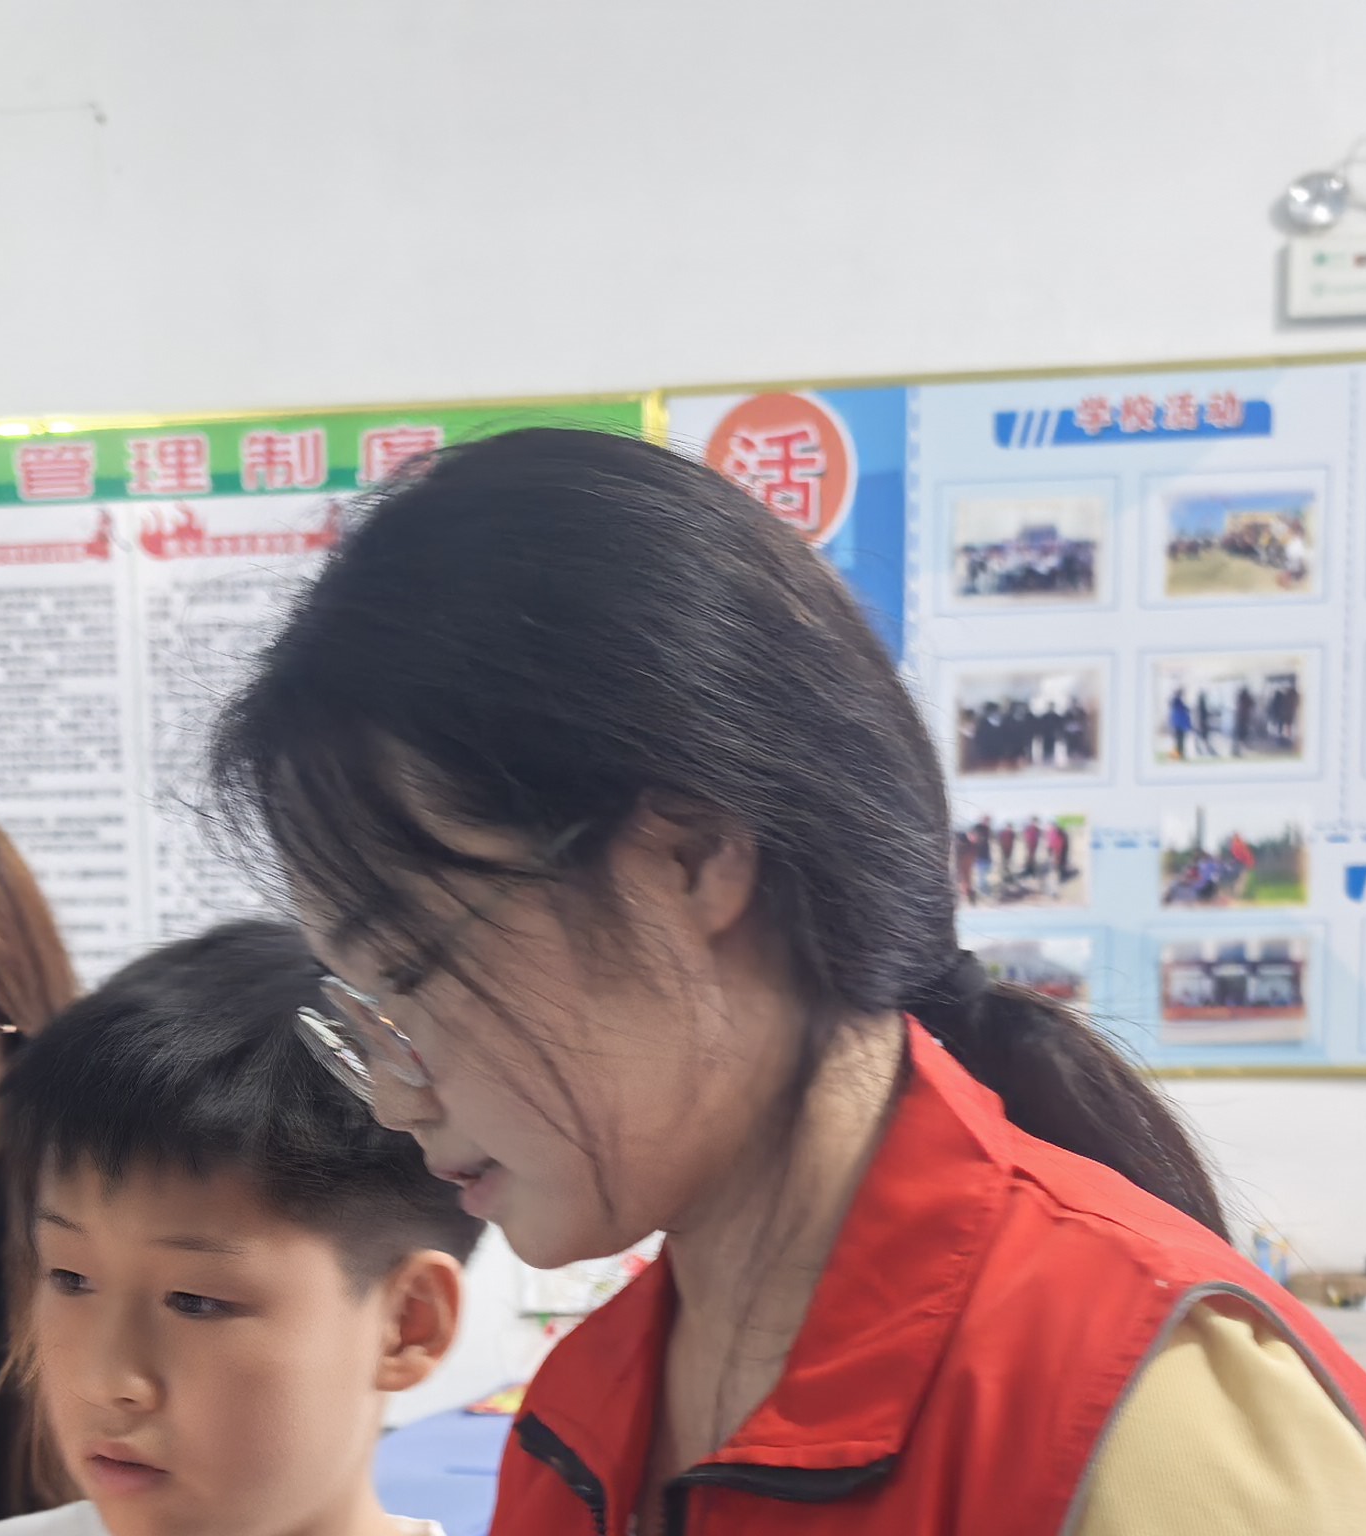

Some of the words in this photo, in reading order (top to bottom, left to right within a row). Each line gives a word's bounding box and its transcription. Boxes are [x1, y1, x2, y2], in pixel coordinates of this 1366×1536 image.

[1073, 391, 1246, 436] 学校活动
[725, 422, 828, 531] 活
